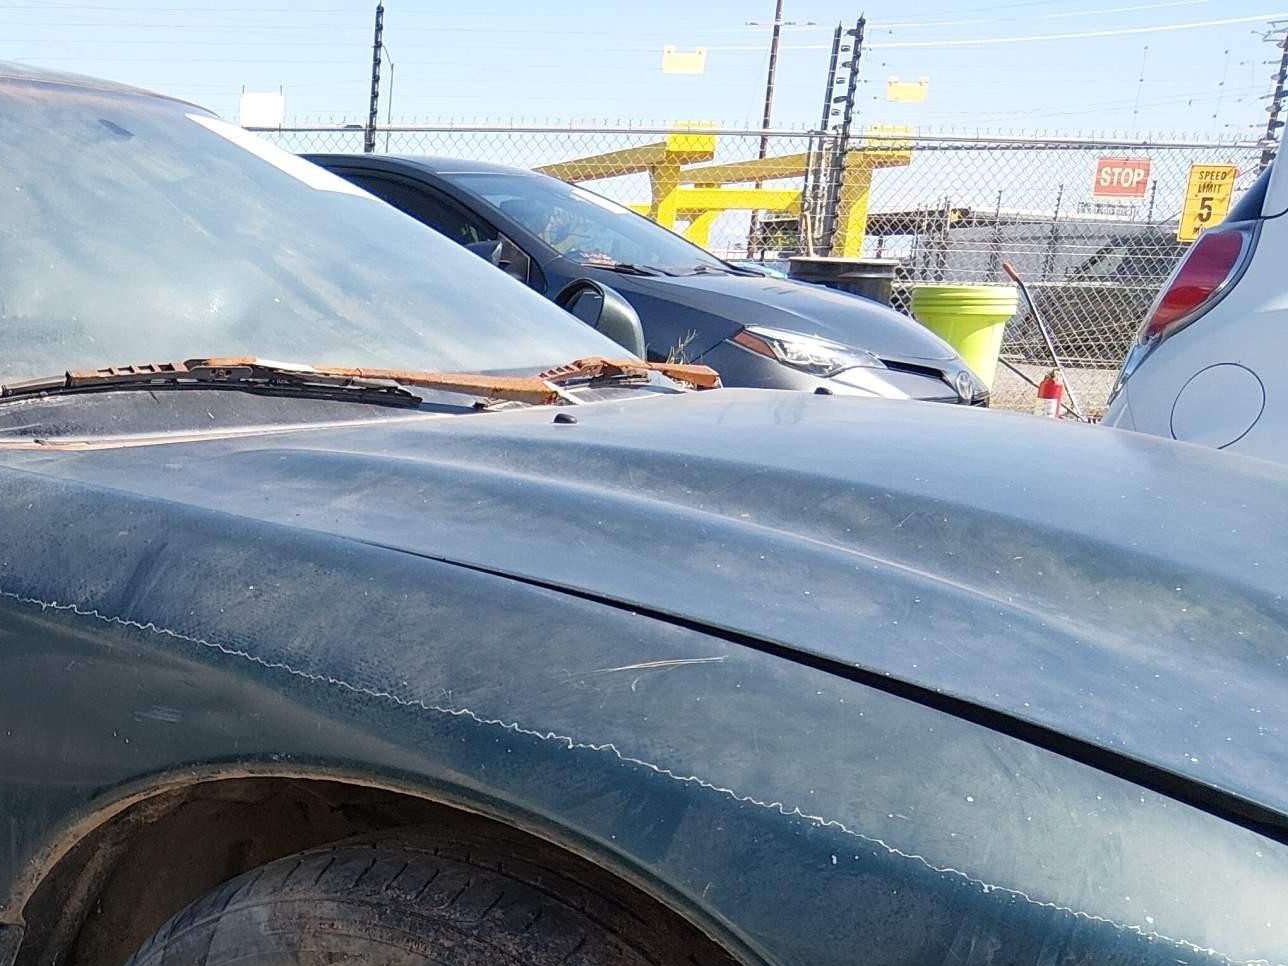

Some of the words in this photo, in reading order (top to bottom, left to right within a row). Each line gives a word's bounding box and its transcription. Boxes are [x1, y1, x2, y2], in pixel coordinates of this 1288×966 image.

[1099, 166, 1145, 188] STOP
[1198, 170, 1228, 181] SPEED
[1197, 183, 1223, 194] LIMIT
[1197, 197, 1214, 223] 5
